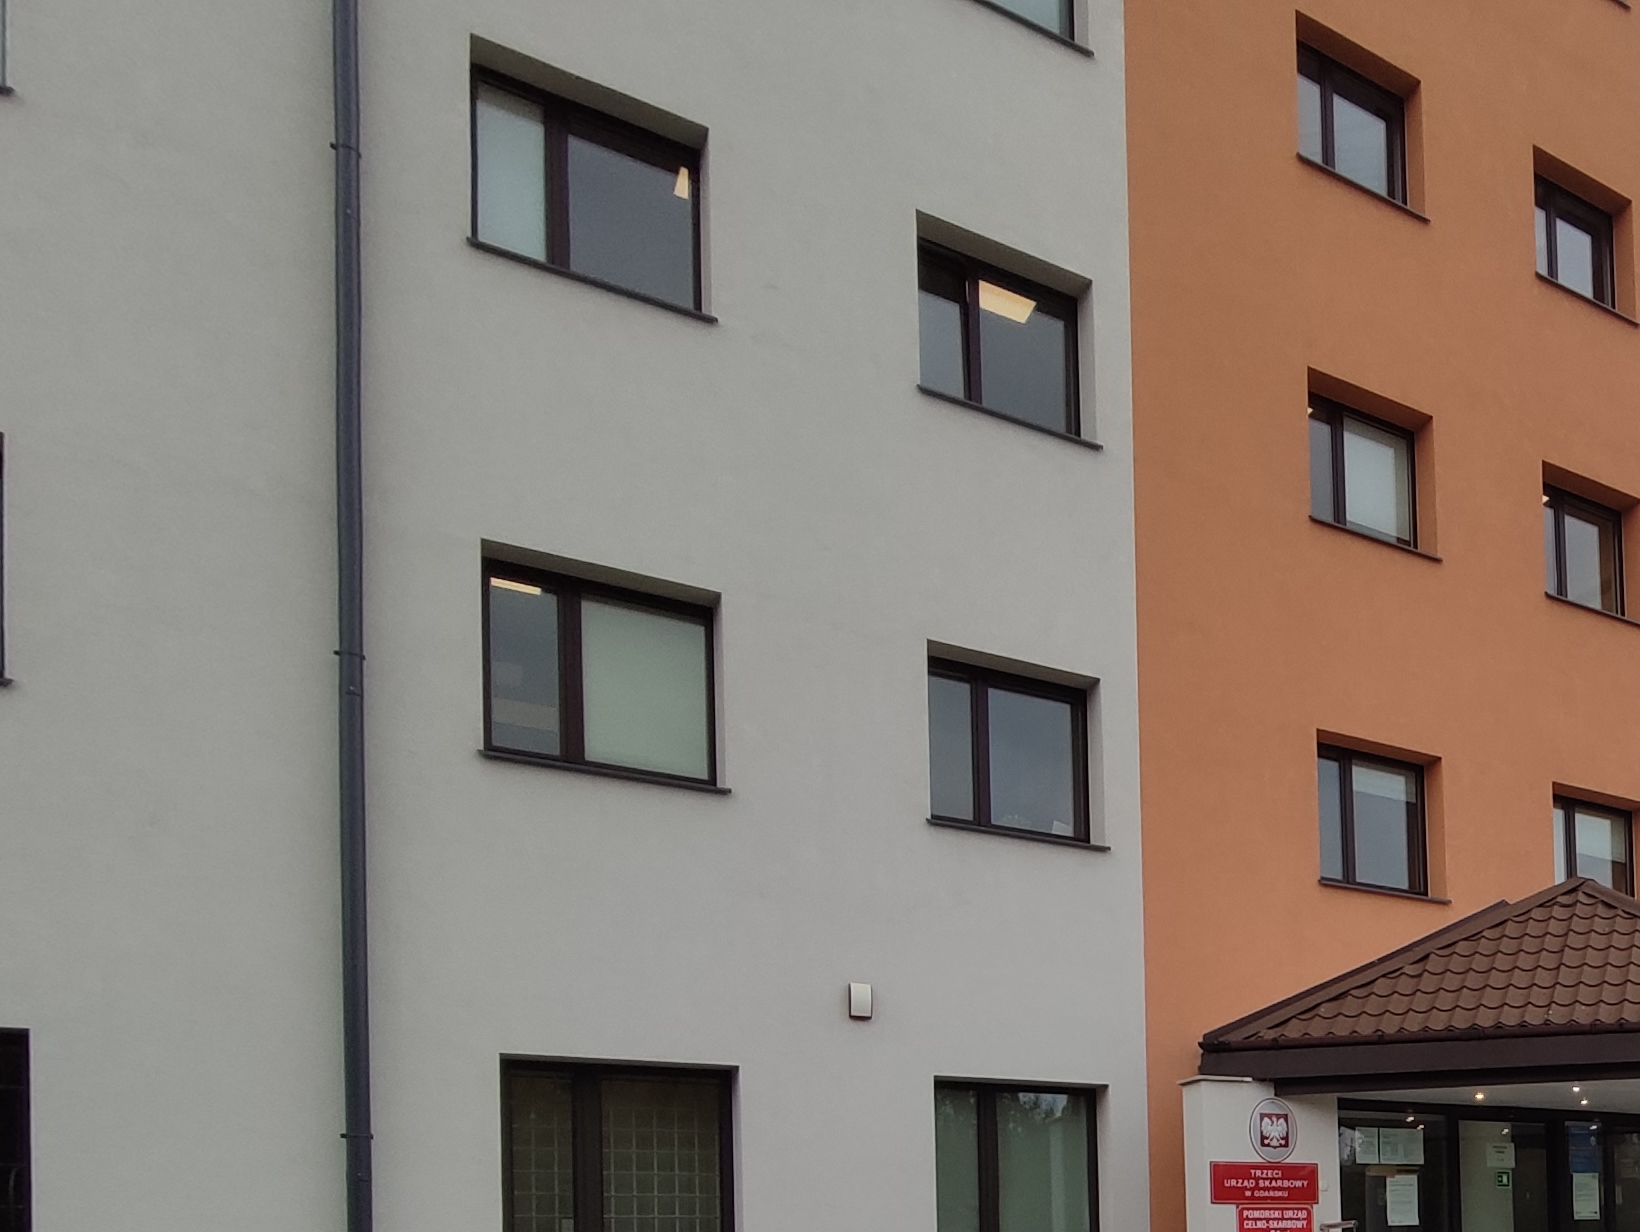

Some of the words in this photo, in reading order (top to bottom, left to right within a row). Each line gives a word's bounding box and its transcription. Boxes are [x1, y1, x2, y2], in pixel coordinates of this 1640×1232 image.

[1250, 1169, 1282, 1178] TRZECI
[1224, 1179, 1256, 1189] URZĄD
[1258, 1180, 1309, 1188] SKARBOWY
[1242, 1210, 1282, 1219] POMORSKI
[1283, 1210, 1308, 1220] URZĄD
